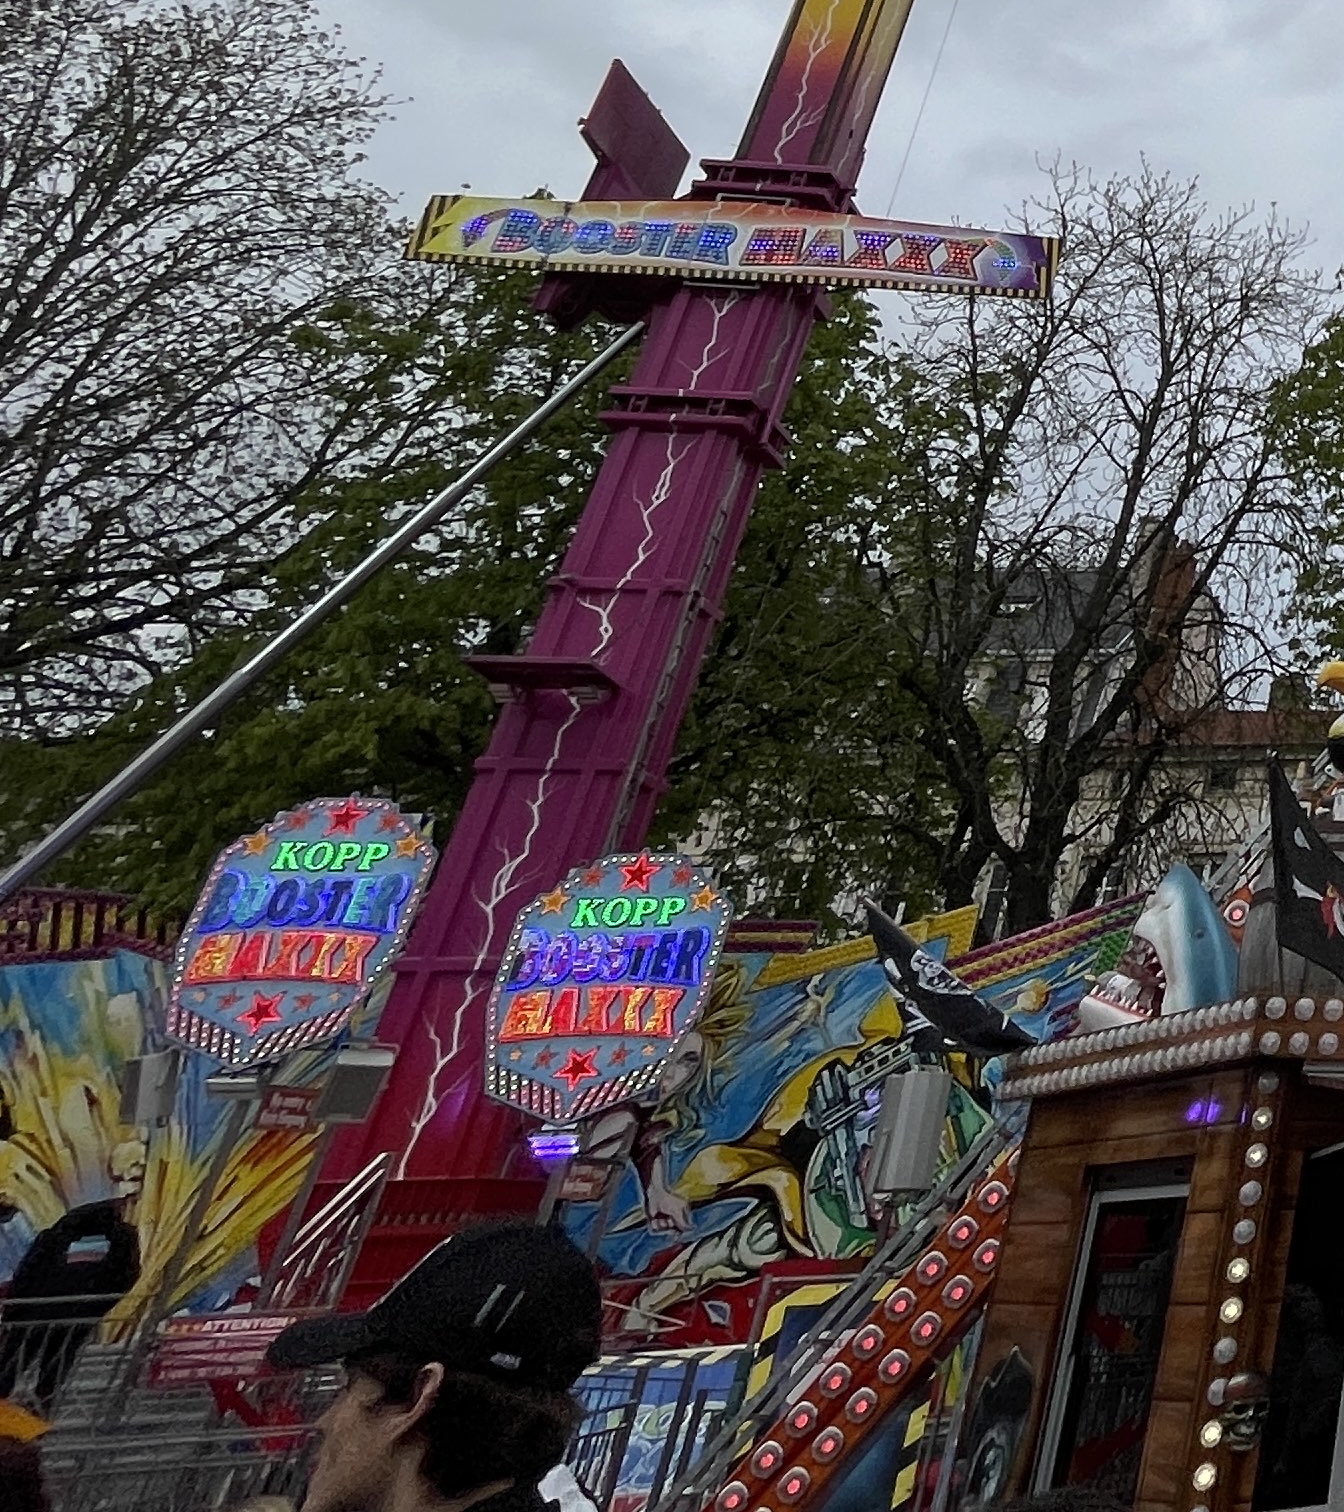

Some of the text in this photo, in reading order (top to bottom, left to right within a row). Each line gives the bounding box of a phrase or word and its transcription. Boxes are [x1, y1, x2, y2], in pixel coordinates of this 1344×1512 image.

[489, 208, 988, 280] BOOSTER MAXXX
[270, 840, 391, 871] KOPP
[197, 868, 412, 934] BOOSTER
[569, 895, 687, 928] KOPP
[183, 931, 379, 984] MAXXX
[504, 925, 711, 991] BOOSTER
[498, 985, 687, 1043] MAXXX
